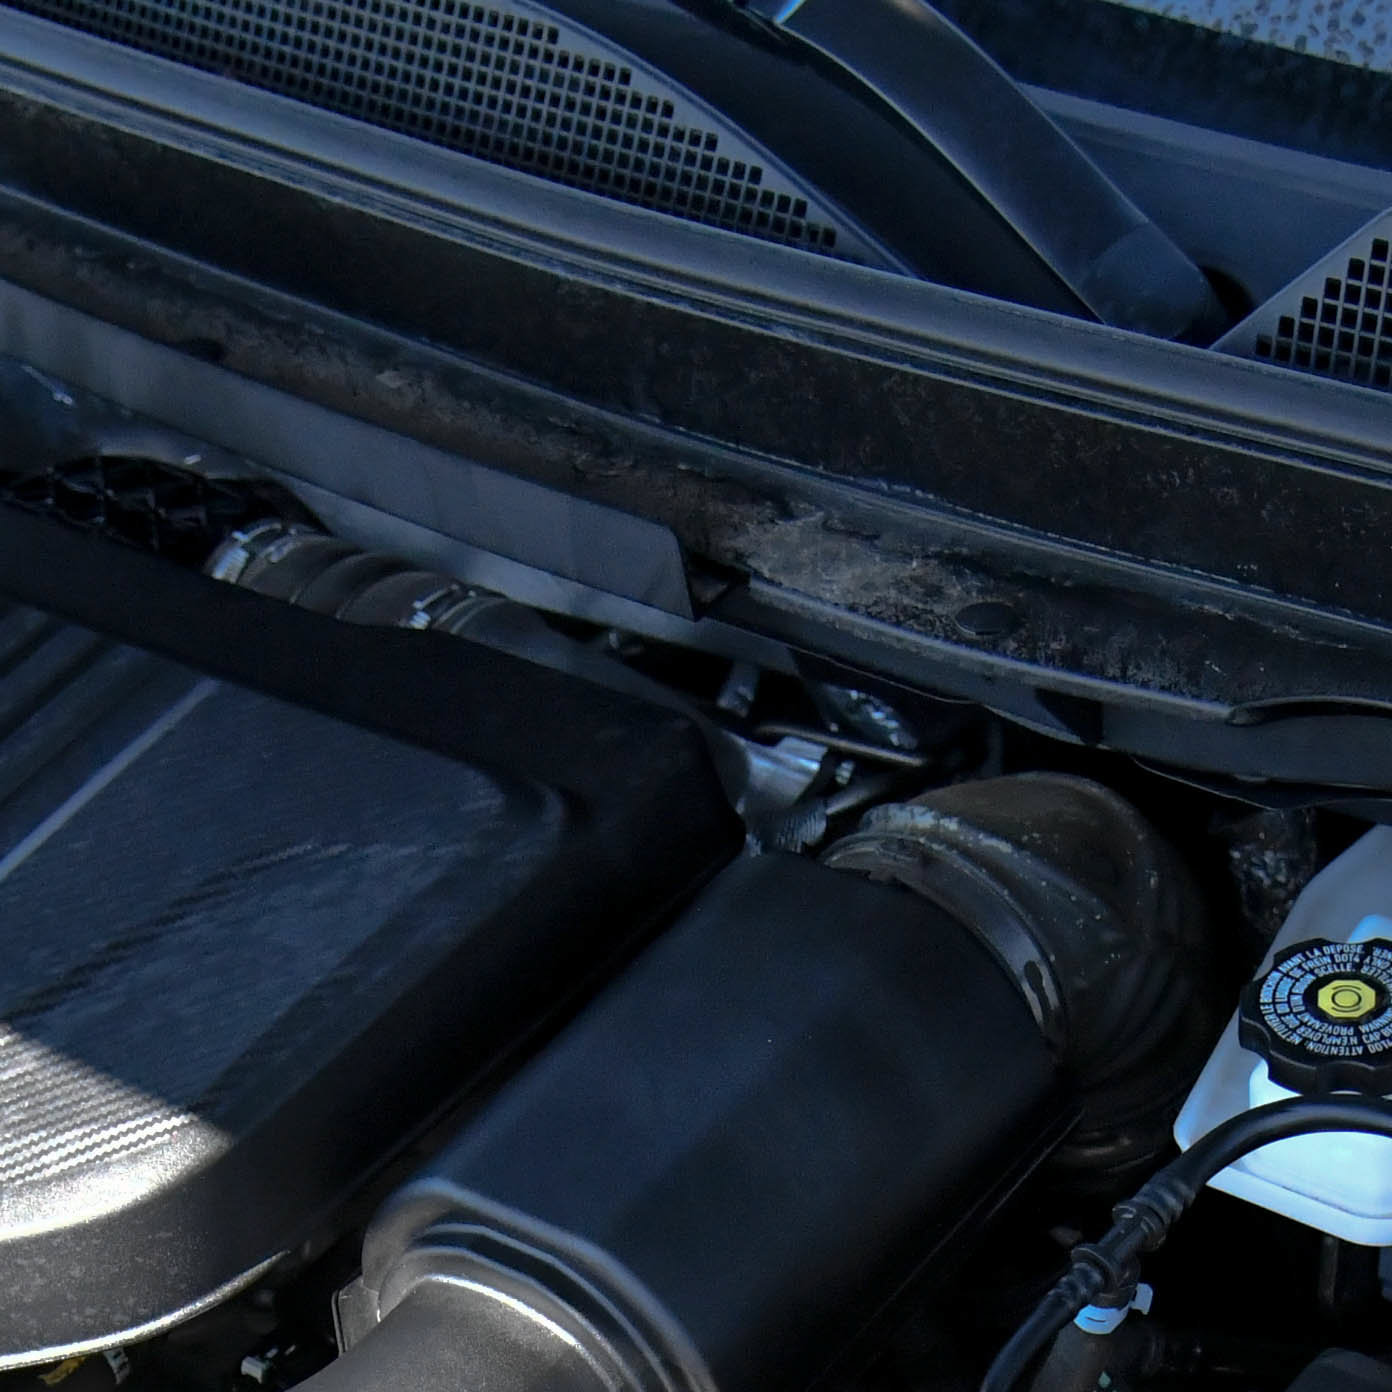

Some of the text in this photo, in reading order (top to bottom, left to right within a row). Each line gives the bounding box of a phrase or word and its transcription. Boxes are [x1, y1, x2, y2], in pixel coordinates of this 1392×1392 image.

[1273, 951, 1305, 971] AVANT
[1299, 954, 1330, 969] FREIN
[1363, 955, 1390, 970] ONLY
[1359, 965, 1392, 984] FILLER
[1263, 1014, 1303, 1044] NETTOYER
[1296, 1012, 1355, 1036] PROVENANT
[1294, 1025, 1358, 1046] N'EMPLOYER
[1362, 1033, 1386, 1045] CAP
